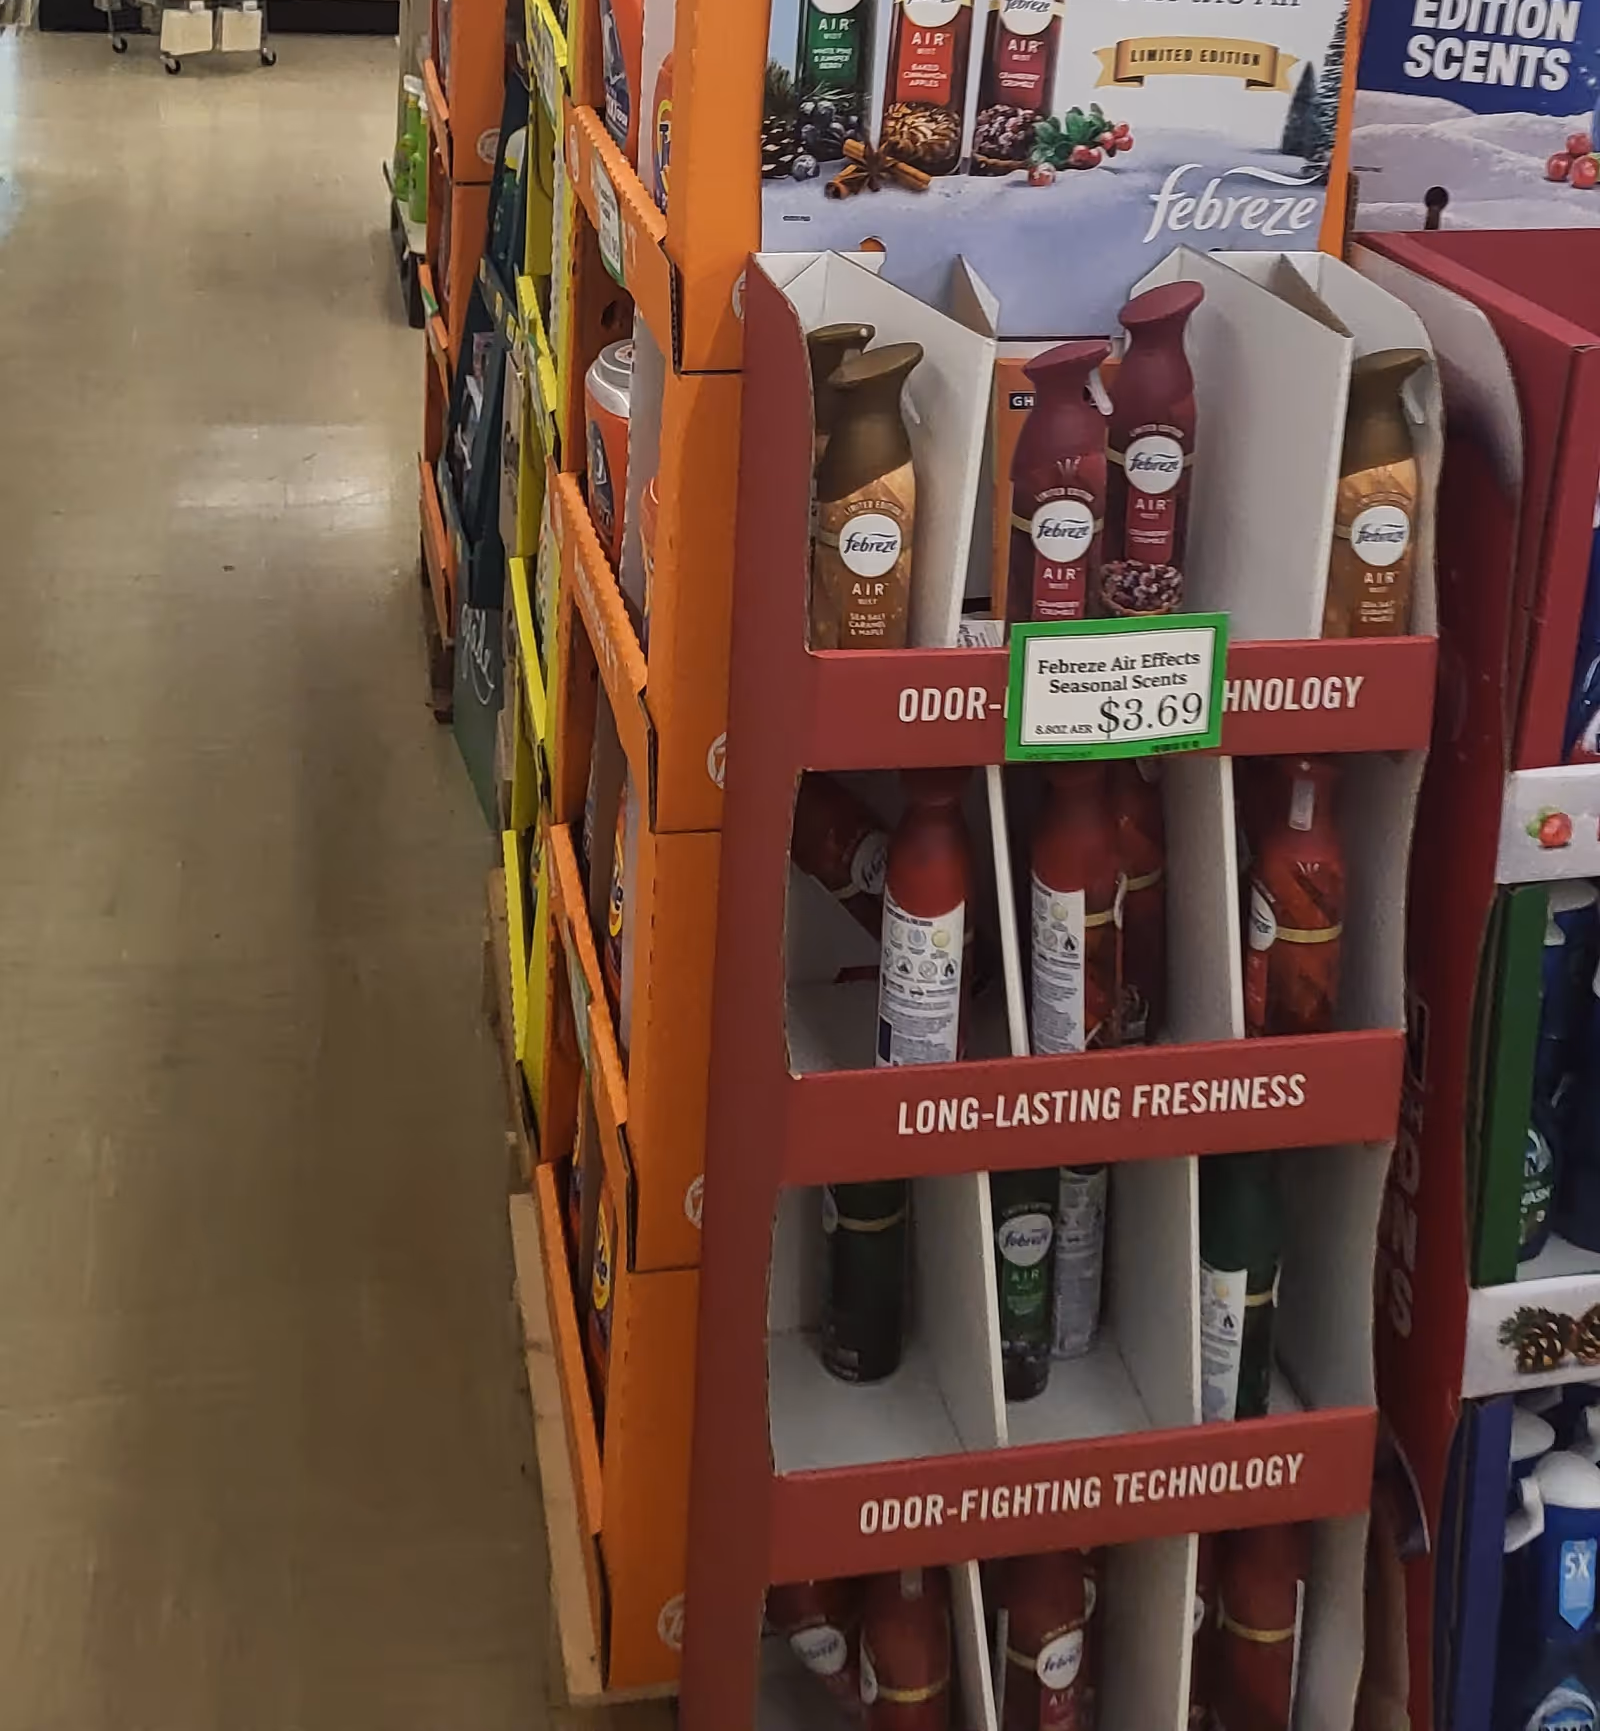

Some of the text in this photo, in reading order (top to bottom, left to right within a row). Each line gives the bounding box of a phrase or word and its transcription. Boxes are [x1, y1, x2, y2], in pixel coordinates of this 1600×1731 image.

[818, 18, 850, 30] AIR
[911, 32, 944, 45] AIR
[1008, 39, 1039, 53] AIR
[1130, 49, 1260, 66] LIMITED EDITION
[1404, 34, 1571, 91] SCENTS
[1143, 163, 1322, 244] febreze
[1013, 396, 1035, 407] GH
[1128, 452, 1179, 473] febreze
[844, 500, 873, 516] LIMITED
[1136, 499, 1167, 511] AIR
[1037, 518, 1090, 539] febreze
[844, 532, 897, 554] febreze
[1043, 568, 1076, 580] AIR
[1364, 572, 1395, 584] AIR
[852, 583, 884, 596] AIR
[1038, 652, 1200, 674] Febreze Air Effects
[1049, 672, 1188, 694] Seasonal Scents
[1223, 675, 1365, 713] HNOLOGY
[1098, 692, 1203, 739] $3.69
[899, 1073, 1307, 1135] LONG-LASTING FRESHNESS
[1011, 1269, 1040, 1281] AIR
[860, 1453, 1304, 1534] ODOR-FIGHTING TECHNOLOGY
[1564, 1552, 1591, 1580] 5X
